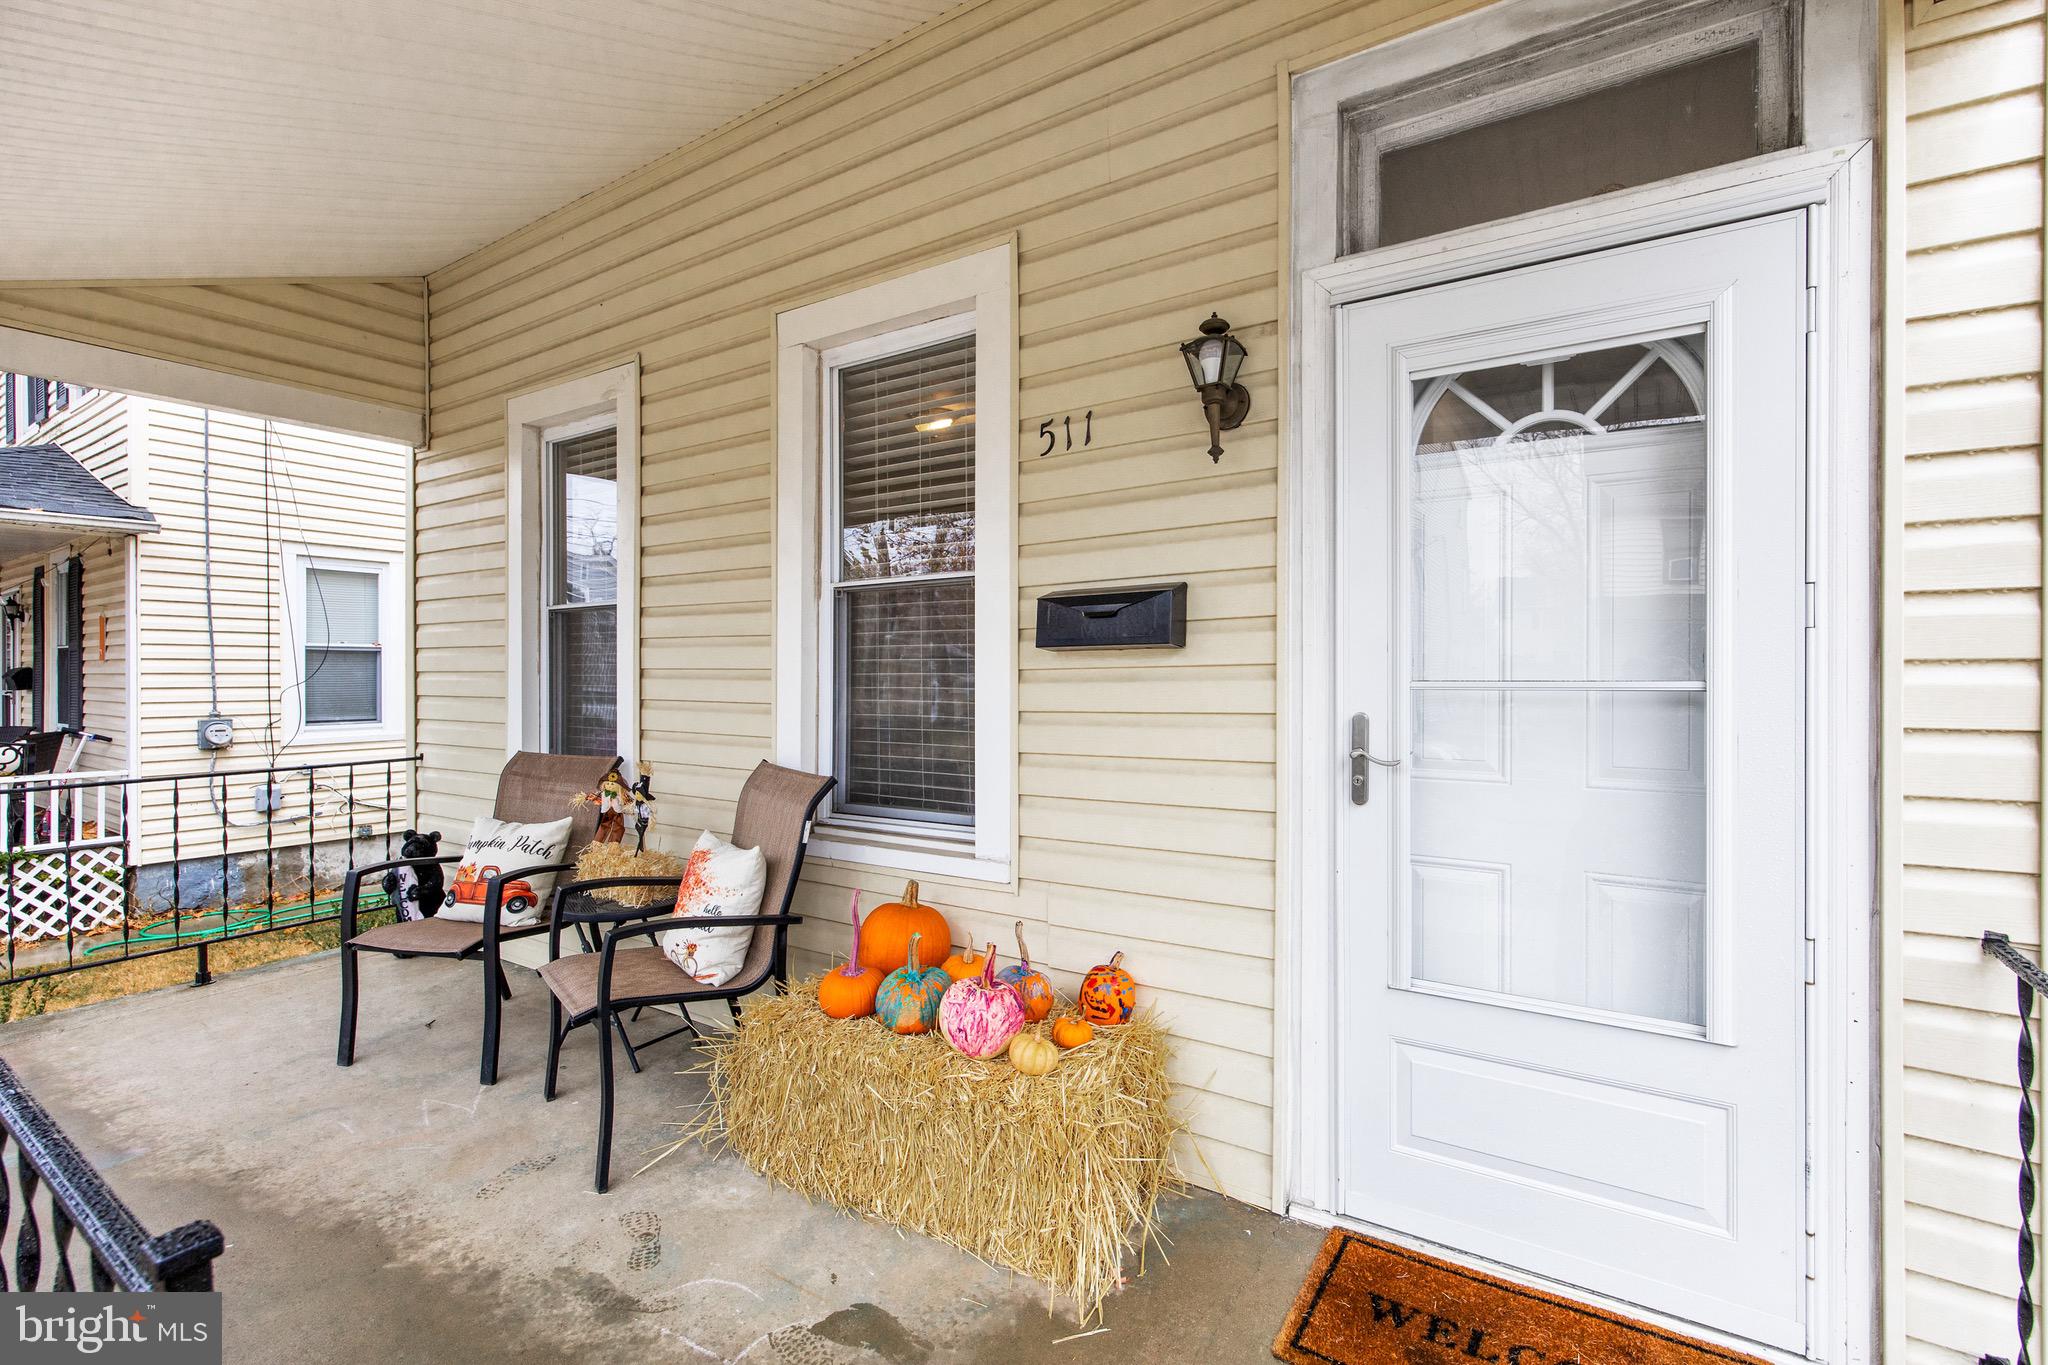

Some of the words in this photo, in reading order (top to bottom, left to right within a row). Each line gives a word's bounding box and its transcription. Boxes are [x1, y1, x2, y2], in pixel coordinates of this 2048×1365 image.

[1040, 410, 1092, 457] 511
[467, 834, 506, 854] umpkin
[507, 835, 556, 860] Patch
[703, 903, 722, 916] hello
[1368, 1291, 1580, 1365] WELC
